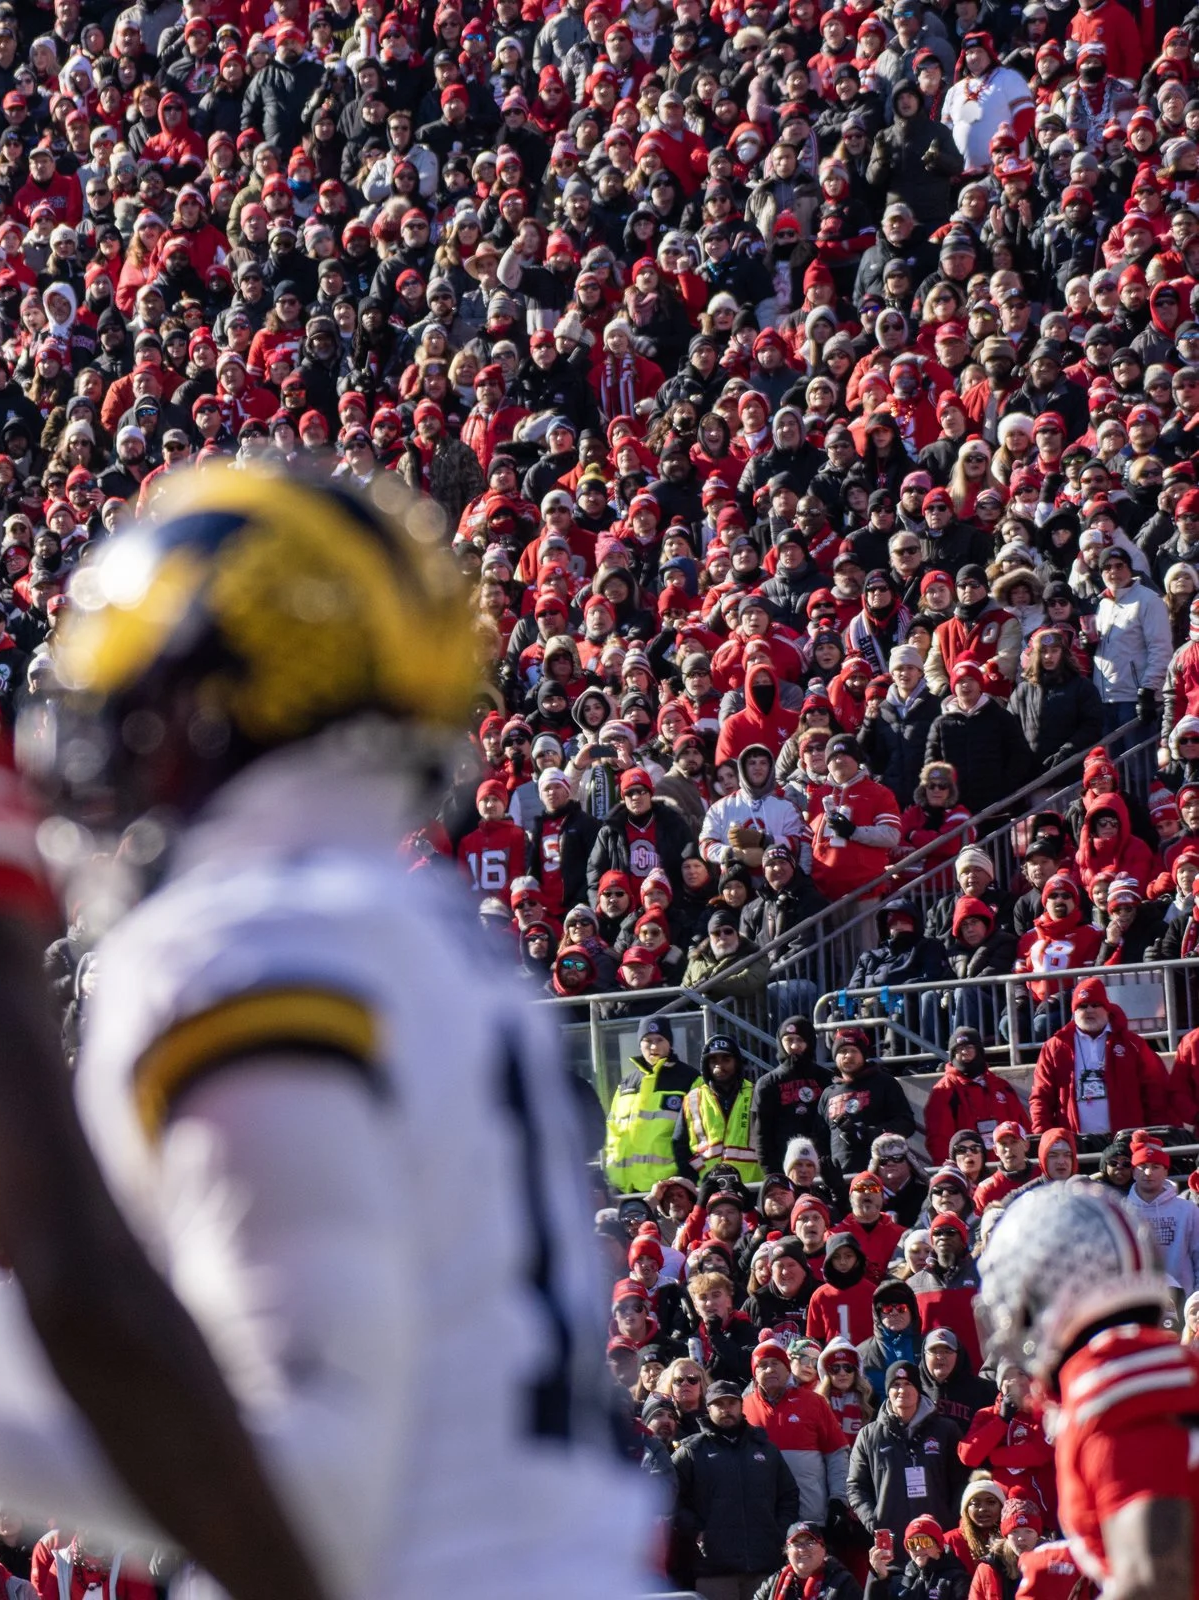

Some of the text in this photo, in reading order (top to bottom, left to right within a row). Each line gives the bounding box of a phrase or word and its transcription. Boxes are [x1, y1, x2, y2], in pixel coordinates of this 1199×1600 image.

[467, 850, 507, 890] 16
[741, 1096, 750, 1128] FIRE
[837, 1304, 851, 1341] 1
[938, 1399, 971, 1421] STATE
